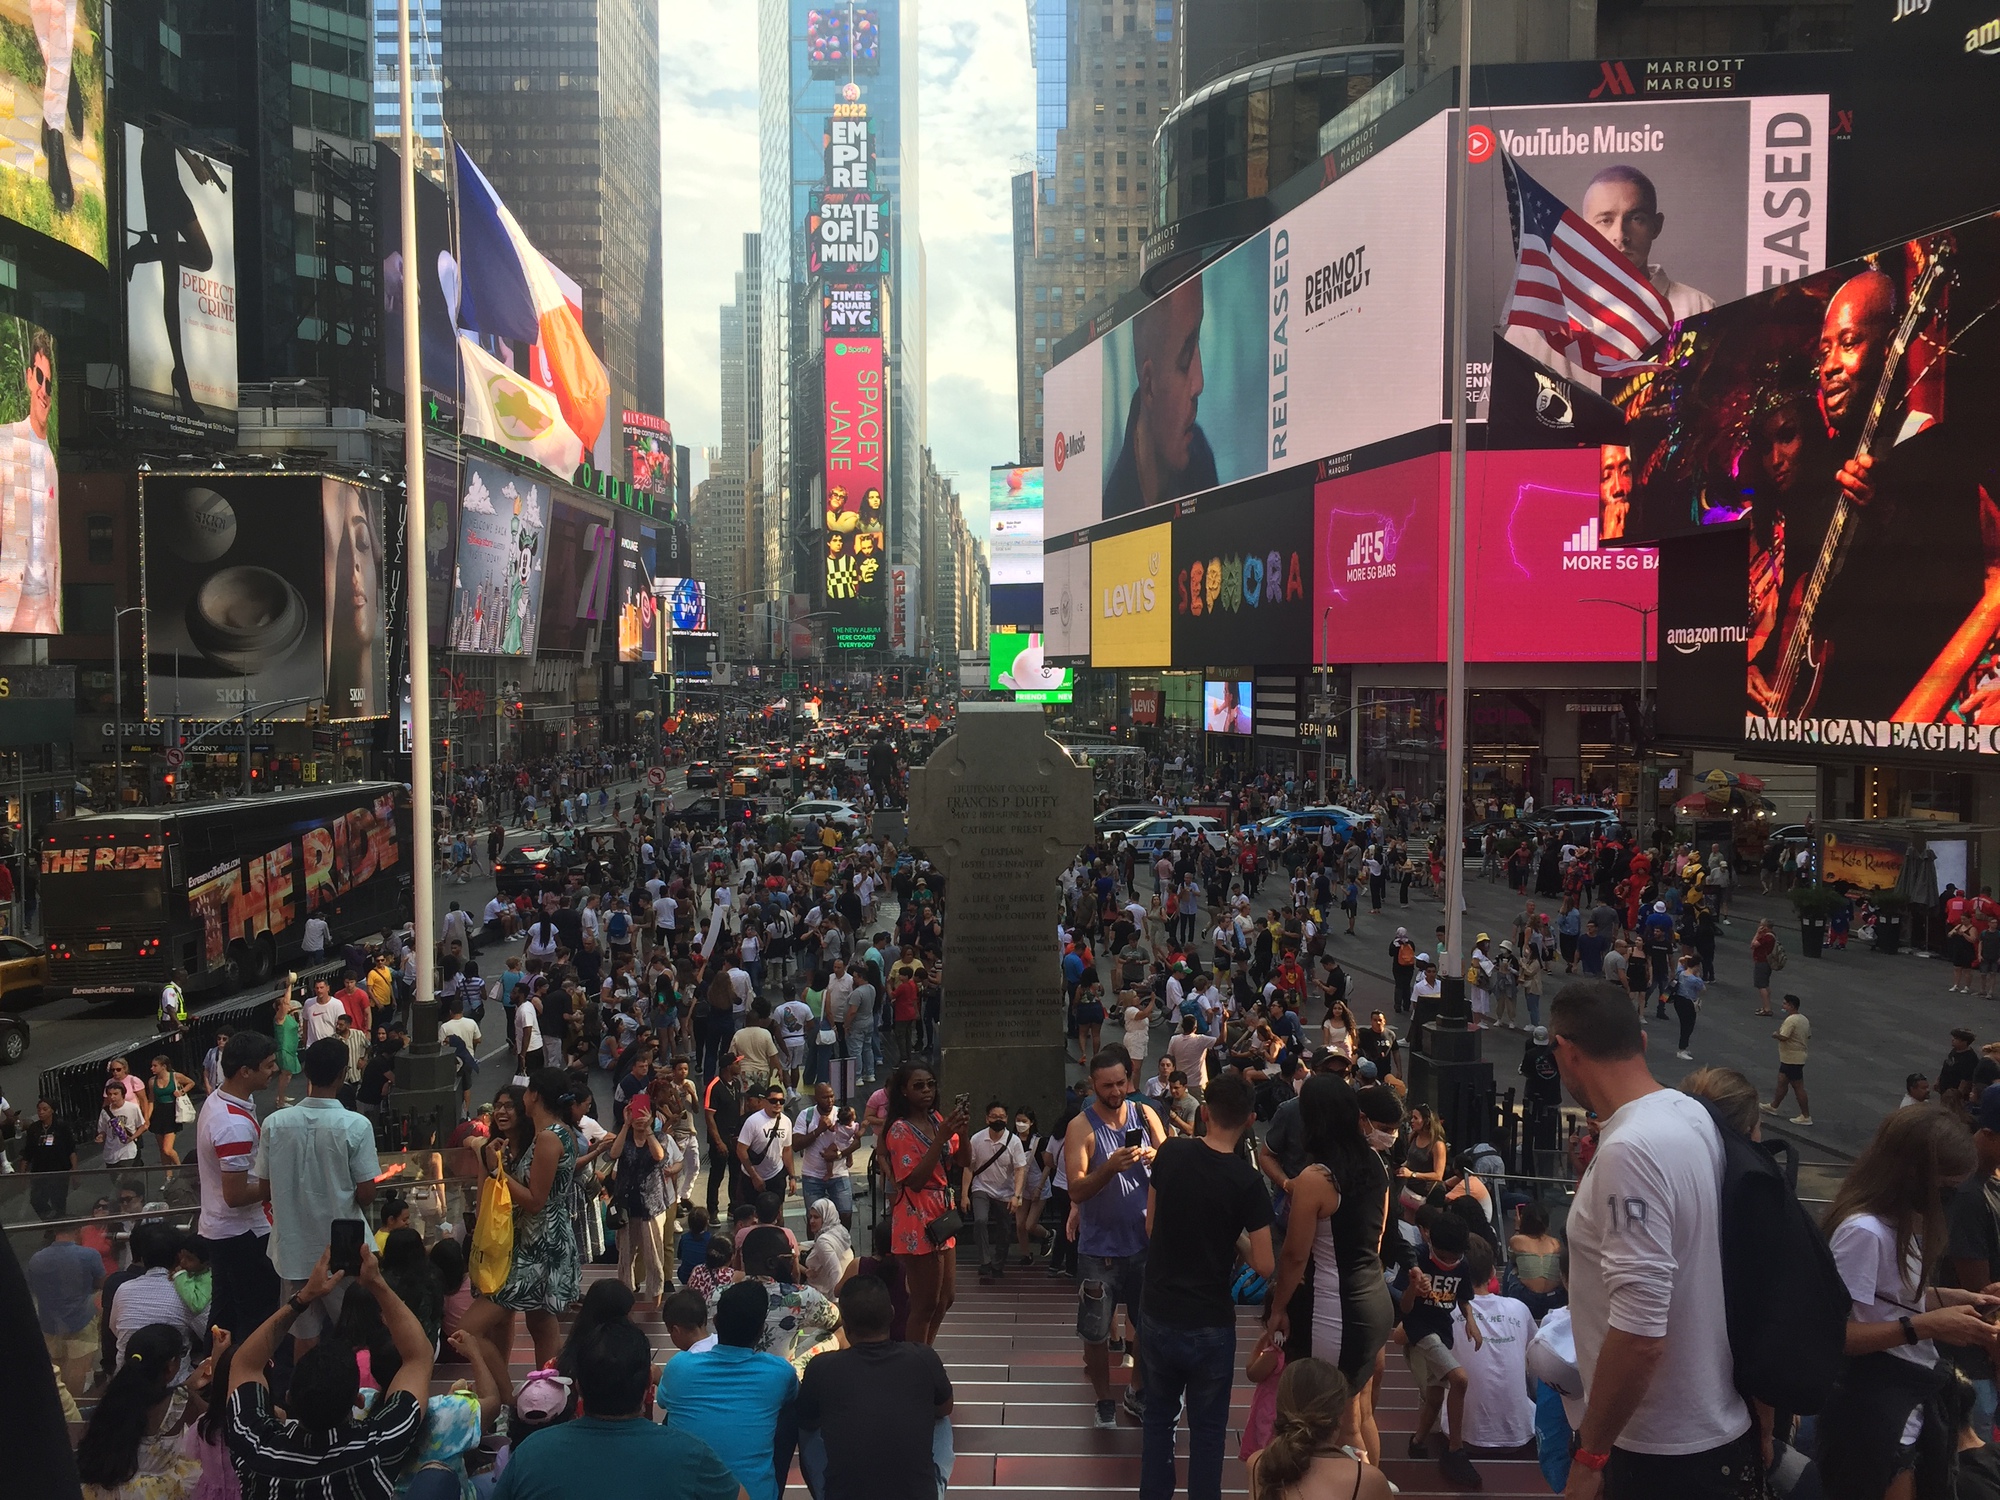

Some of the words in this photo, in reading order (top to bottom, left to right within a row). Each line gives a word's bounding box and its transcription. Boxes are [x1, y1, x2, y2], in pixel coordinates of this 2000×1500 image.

[1646, 58, 1746, 74] MARRIOTT
[1646, 75, 1733, 91] MARQUIS
[833, 103, 867, 117] 2022
[1340, 123, 1379, 157] MARRIOTT
[1499, 127, 1588, 157] YouTube
[1593, 124, 1664, 153] Music
[1340, 142, 1374, 172] MARQUIS
[821, 204, 879, 243] STATE
[821, 221, 853, 242] OF
[1147, 223, 1180, 250] MARRIOTT
[821, 231, 879, 262] MIND
[1147, 239, 1175, 263] MARQUIS
[1305, 245, 1366, 300] DERMOT
[182, 272, 234, 304] PERFECT
[831, 290, 871, 301] TIMES
[1305, 268, 1371, 317] KENNEDY
[198, 298, 234, 323] CRIME
[831, 302, 871, 312] SQUARE
[831, 311, 871, 326] NYC
[848, 345, 872, 355] Spotify
[1272, 228, 1290, 461] RELEASED
[133, 406, 143, 415] The
[142, 408, 160, 419] Theater
[160, 411, 176, 421] Center
[857, 369, 879, 473] SPACEY
[830, 401, 852, 471] JANE
[1328, 453, 1353, 466] MARRIOTT
[572, 463, 655, 515] OADWAY
[670, 527, 678, 559] 1500
[1562, 555, 1612, 570] MORE
[1615, 555, 1639, 570] 5G
[1346, 567, 1367, 583] MORE
[1367, 565, 1377, 580] 5G
[1377, 563, 1397, 579] BARS
[1178, 550, 1303, 617] SEPHORA
[858, 626, 881, 634] ALBUM
[1667, 626, 1718, 645] amazon
[838, 641, 875, 649] EVERYBODY
[1312, 665, 1334, 674] SEPHRA
[350, 688, 366, 701] SKKN
[1016, 693, 1047, 701] FRIENDS
[101, 722, 161, 736] GFTS
[1746, 717, 1877, 747] AMERICAN
[1890, 721, 1981, 752] EAGLE
[953, 785, 1005, 794] LIEUTENANT
[1008, 785, 1050, 793] COLONEL
[947, 796, 999, 808] FRANCIS
[1002, 796, 1010, 807] P
[1015, 796, 1059, 808] DUFFY
[953, 811, 970, 819] MAY
[960, 825, 1005, 834] CATHOLIC
[1011, 825, 1044, 833] PRIEST
[41, 849, 89, 874] THE
[93, 845, 165, 872] RIDE
[302, 791, 400, 914] RIDE
[980, 847, 1024, 856] CHAPLAIN
[1841, 849, 1862, 868] Kite
[972, 872, 991, 880] OLD
[963, 895, 969, 903] A
[972, 895, 990, 903] LIFE
[1009, 894, 1045, 902] SERVICE
[188, 842, 296, 973] THE
[959, 912, 980, 921] GOD
[983, 912, 1002, 920] AND
[1005, 911, 1047, 920] COUNTRY
[1030, 944, 1059, 952] GUARD
[763, 1128, 786, 1138] VNS
